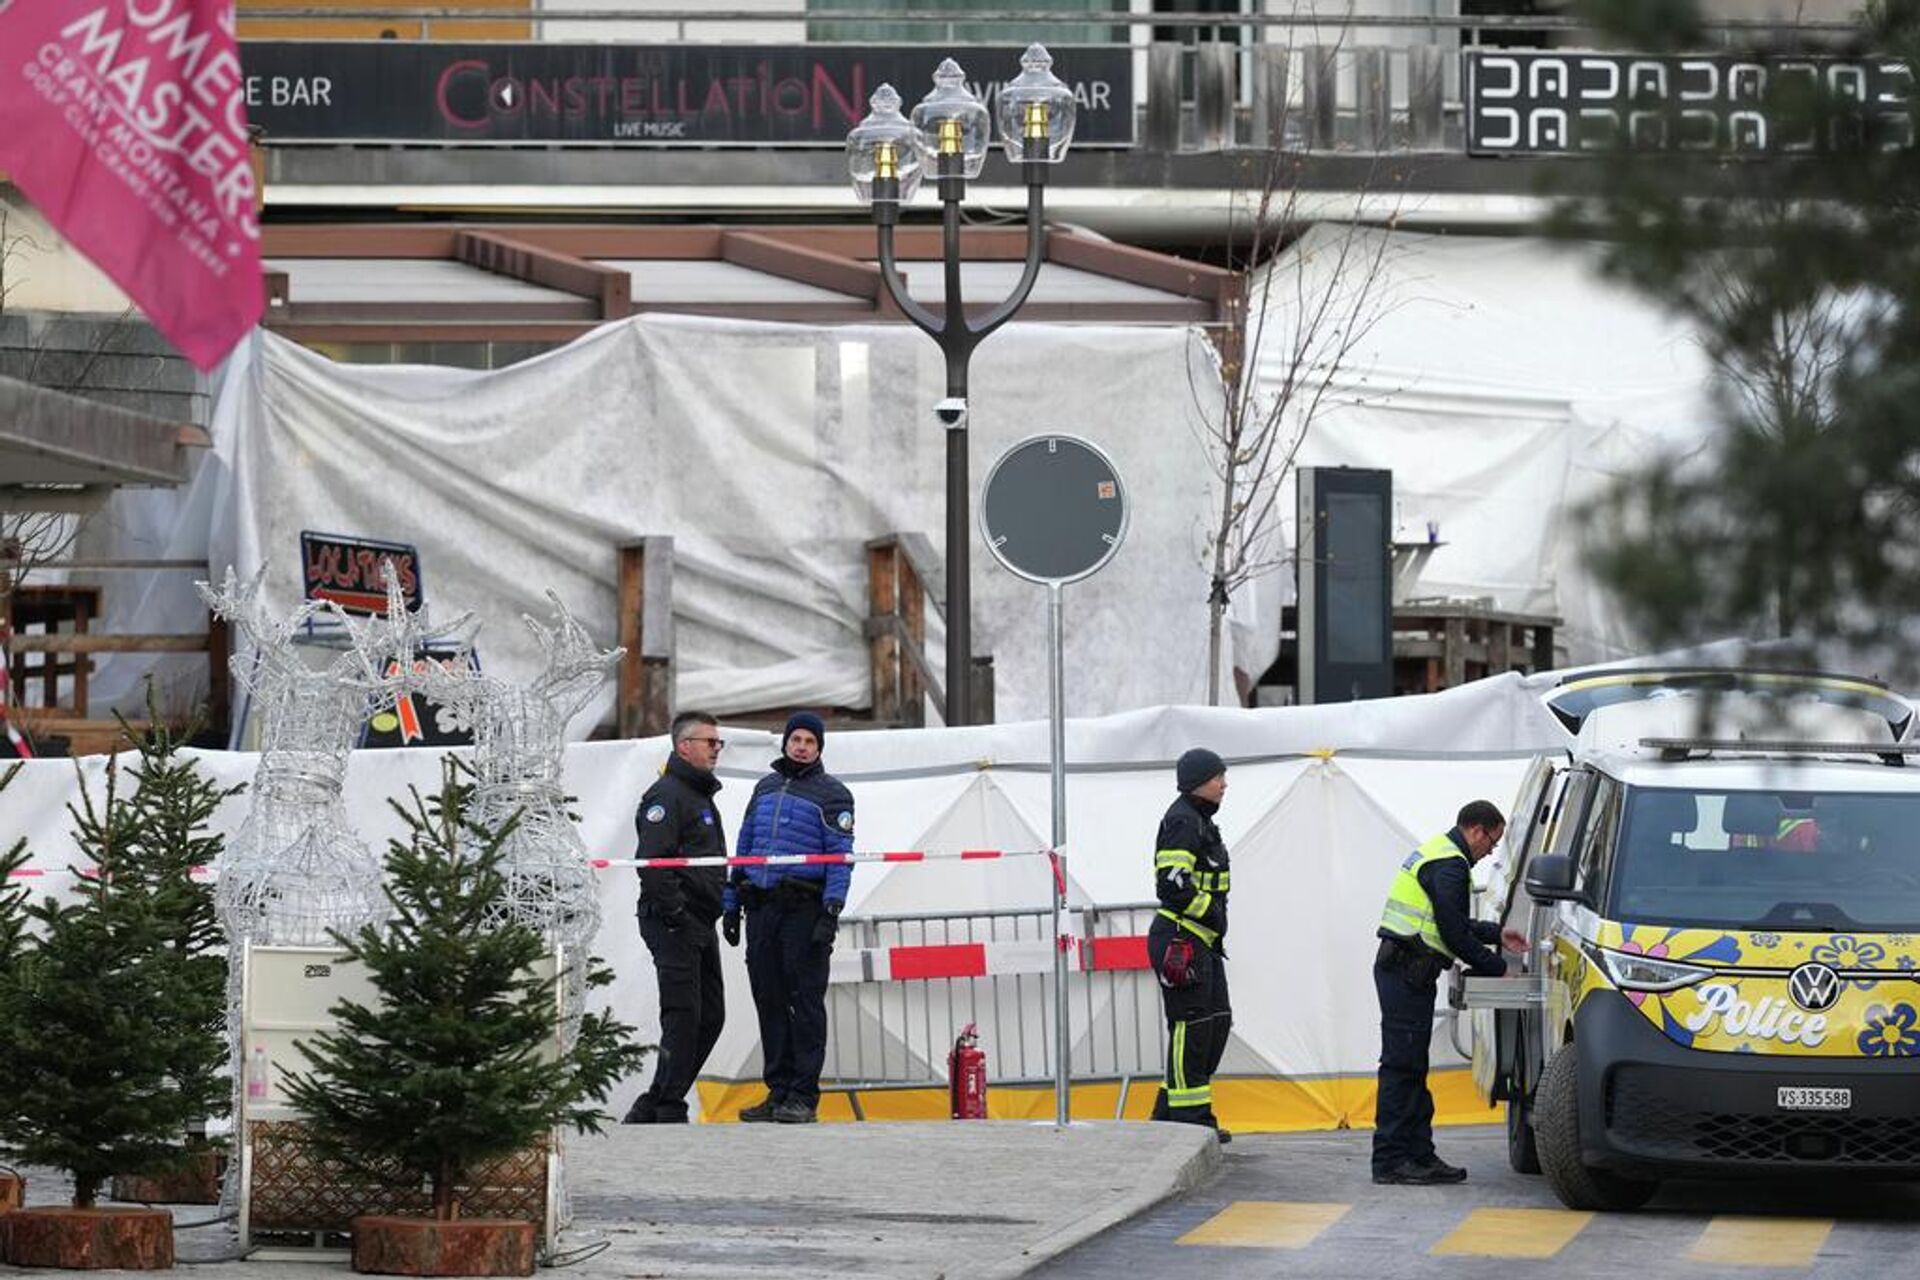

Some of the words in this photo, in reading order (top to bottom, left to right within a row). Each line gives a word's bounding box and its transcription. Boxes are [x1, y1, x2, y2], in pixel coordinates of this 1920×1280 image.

[271, 76, 332, 106] BAR
[1072, 80, 1112, 111] AR
[613, 121, 641, 137] LIVE
[643, 121, 687, 137] MUSIC
[106, 118, 221, 241] MONTANA
[1686, 983, 1828, 1047] Police
